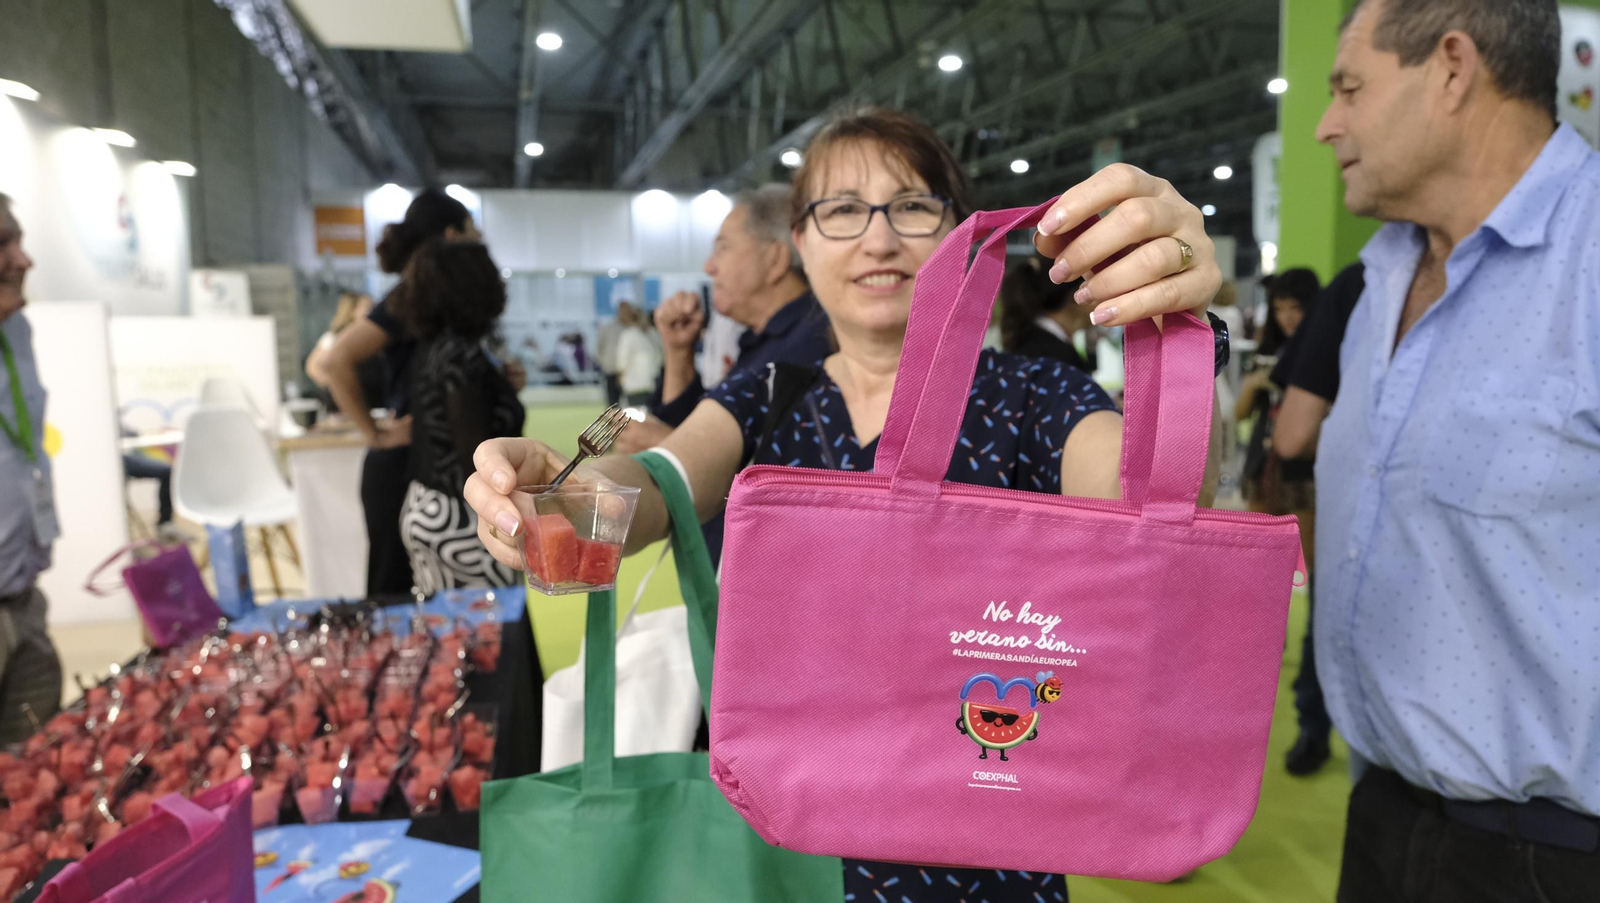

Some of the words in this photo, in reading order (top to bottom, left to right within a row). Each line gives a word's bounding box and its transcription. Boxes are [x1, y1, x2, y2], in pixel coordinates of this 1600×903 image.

[982, 601, 1013, 622] No
[1016, 601, 1062, 632] hay
[949, 629, 1031, 649] verano
[1034, 633, 1087, 654] sin...
[952, 649, 1078, 667] #LAPRIMERASANDÍAEUROPEA
[972, 771, 1019, 784] COEXPHAL
